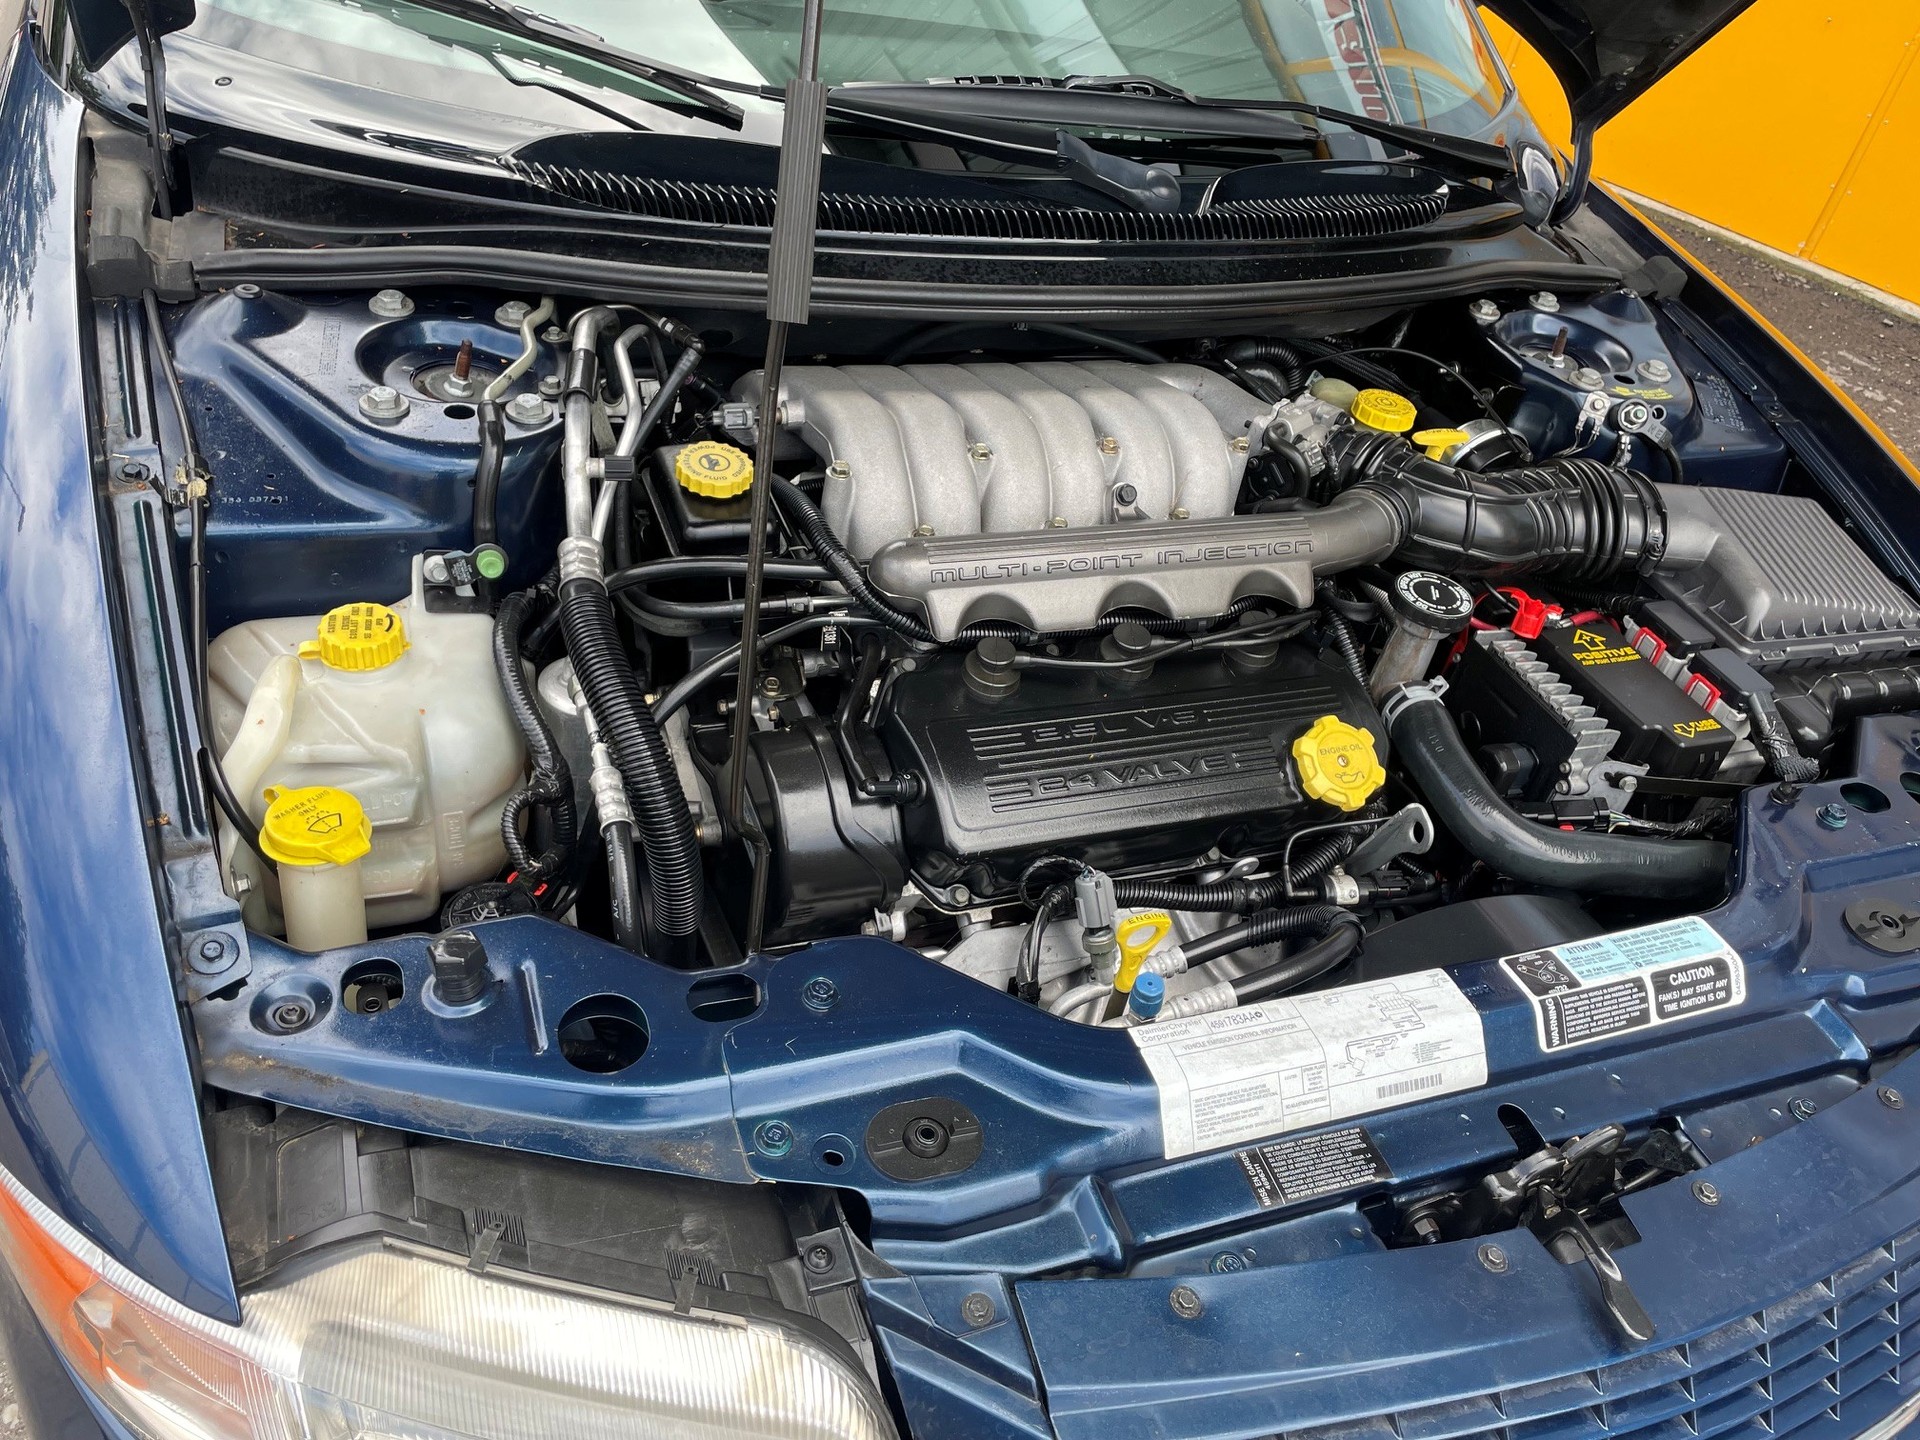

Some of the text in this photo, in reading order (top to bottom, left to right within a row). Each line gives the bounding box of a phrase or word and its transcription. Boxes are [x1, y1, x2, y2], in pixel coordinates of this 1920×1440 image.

[1157, 540, 1314, 565] INJECTION
[1572, 646, 1637, 661] POSITIVE
[1320, 743, 1363, 755] ENGINE OIL
[1037, 753, 1229, 795] 24 VALVE
[274, 801, 305, 820] WASHER
[298, 805, 317, 817] ONLY
[1566, 941, 1602, 954] ATTENTION
[1669, 964, 1715, 986] CAUTION
[1658, 978, 1729, 1003] FAN(S) MAY START ANY
[1663, 989, 1726, 1013] TIME IGNITION IS ON
[1137, 1018, 1202, 1037] DaimlerChrysler
[1548, 998, 1560, 1047] WARNING
[1141, 1029, 1190, 1043] Corporation
[1182, 1040, 1206, 1051] VEHICLE
[1235, 1030, 1260, 1042] CONTROL
[1239, 1151, 1272, 1206] MISE EN GARDE
